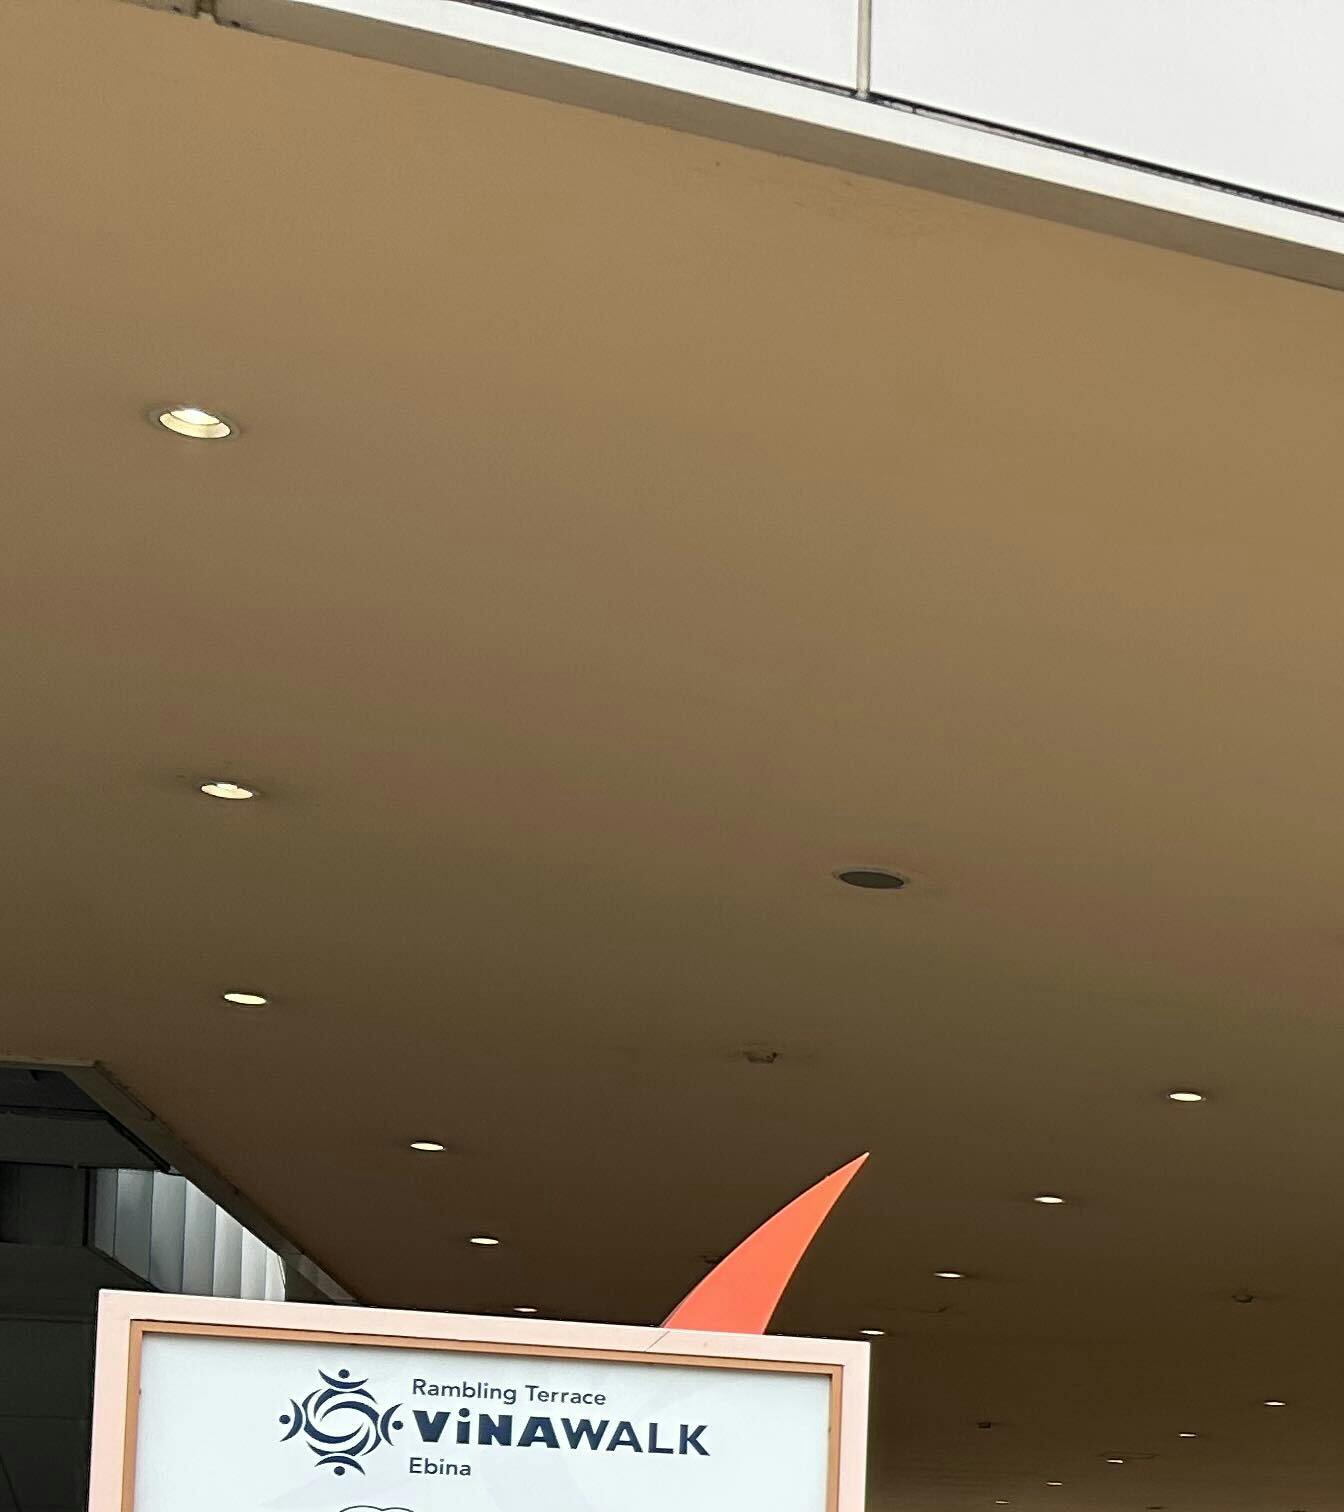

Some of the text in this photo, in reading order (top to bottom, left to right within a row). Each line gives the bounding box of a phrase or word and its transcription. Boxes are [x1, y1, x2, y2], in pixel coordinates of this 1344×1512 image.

[412, 1378, 607, 1407] Rambling Terrace
[412, 1407, 710, 1457] ViNAWALK
[408, 1458, 472, 1478] Ebina
